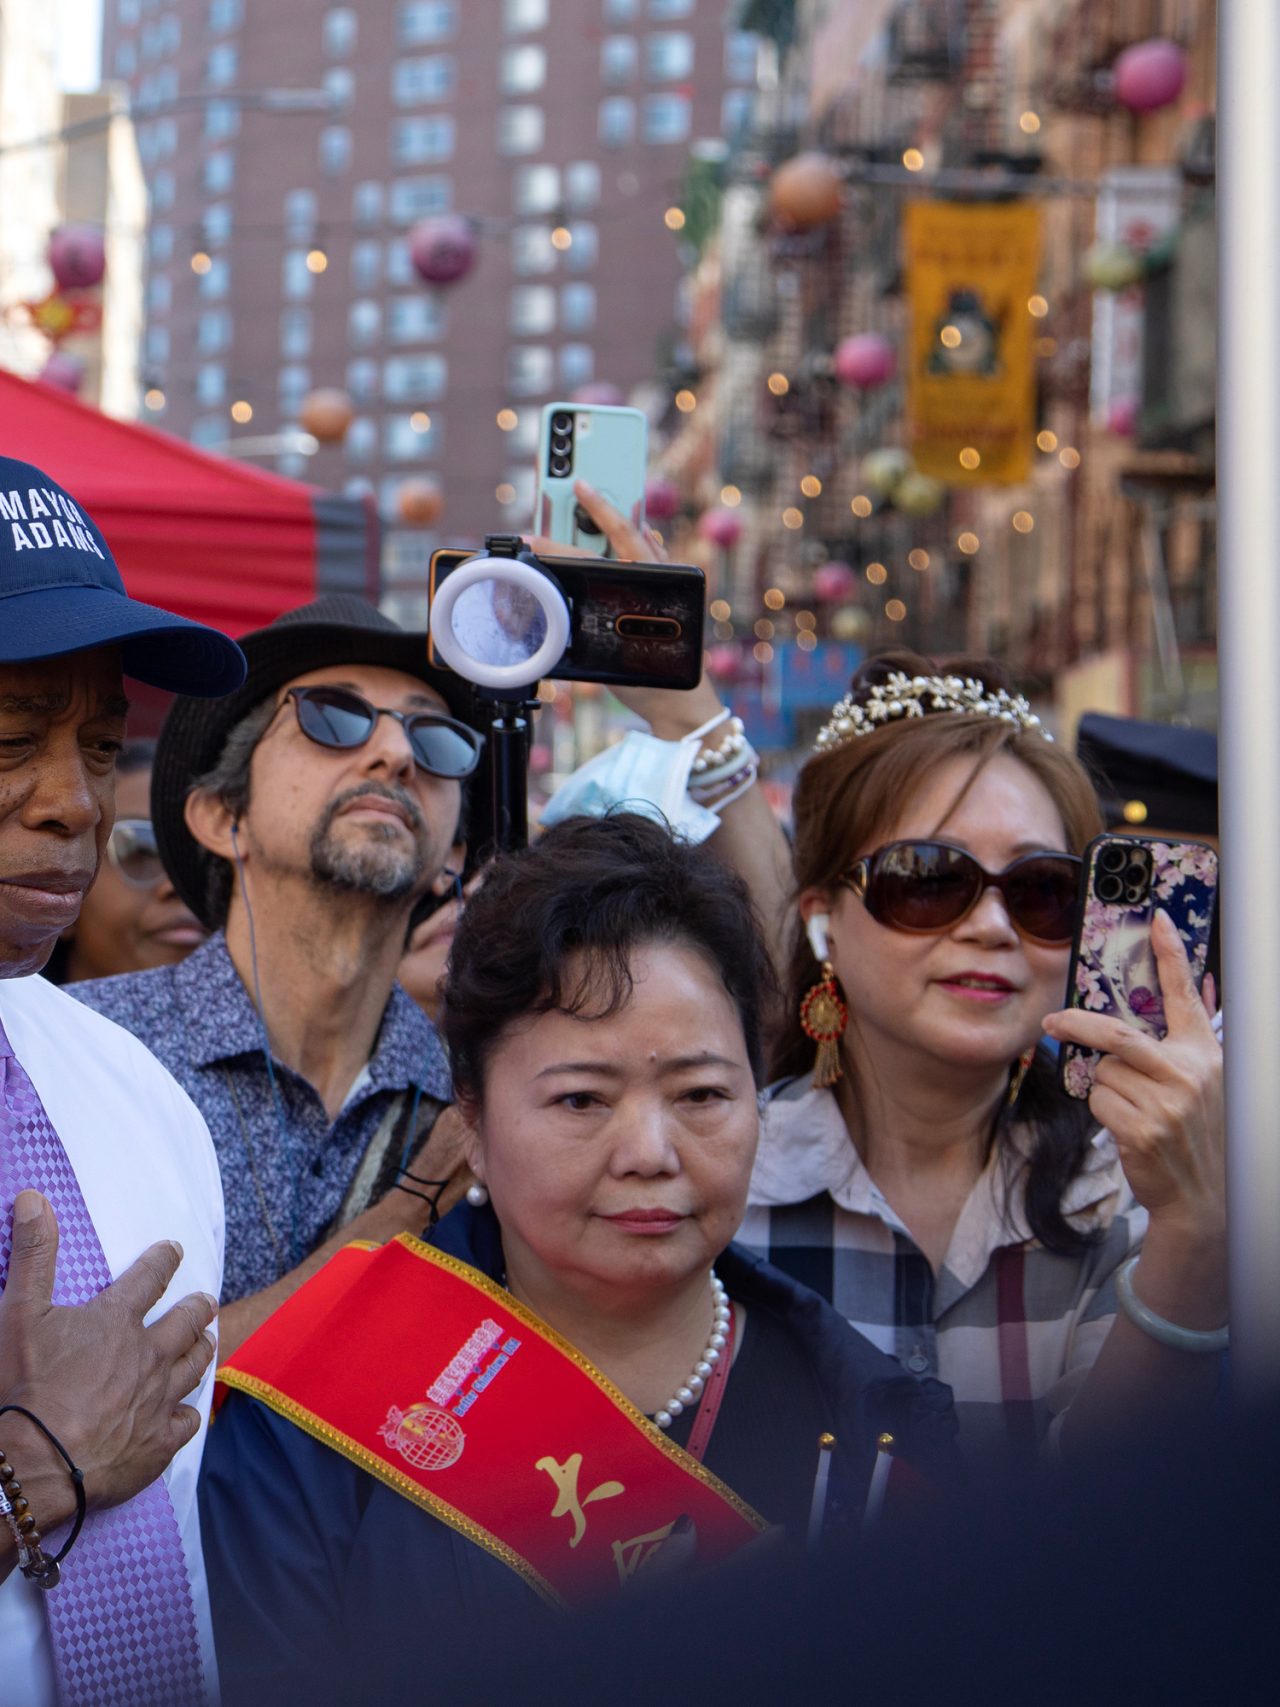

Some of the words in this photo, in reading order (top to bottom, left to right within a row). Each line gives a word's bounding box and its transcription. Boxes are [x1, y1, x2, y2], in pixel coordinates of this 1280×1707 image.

[452, 1390, 479, 1418] Better
[472, 1353, 510, 1393] Chinatown
[501, 1336, 522, 1356] USA
